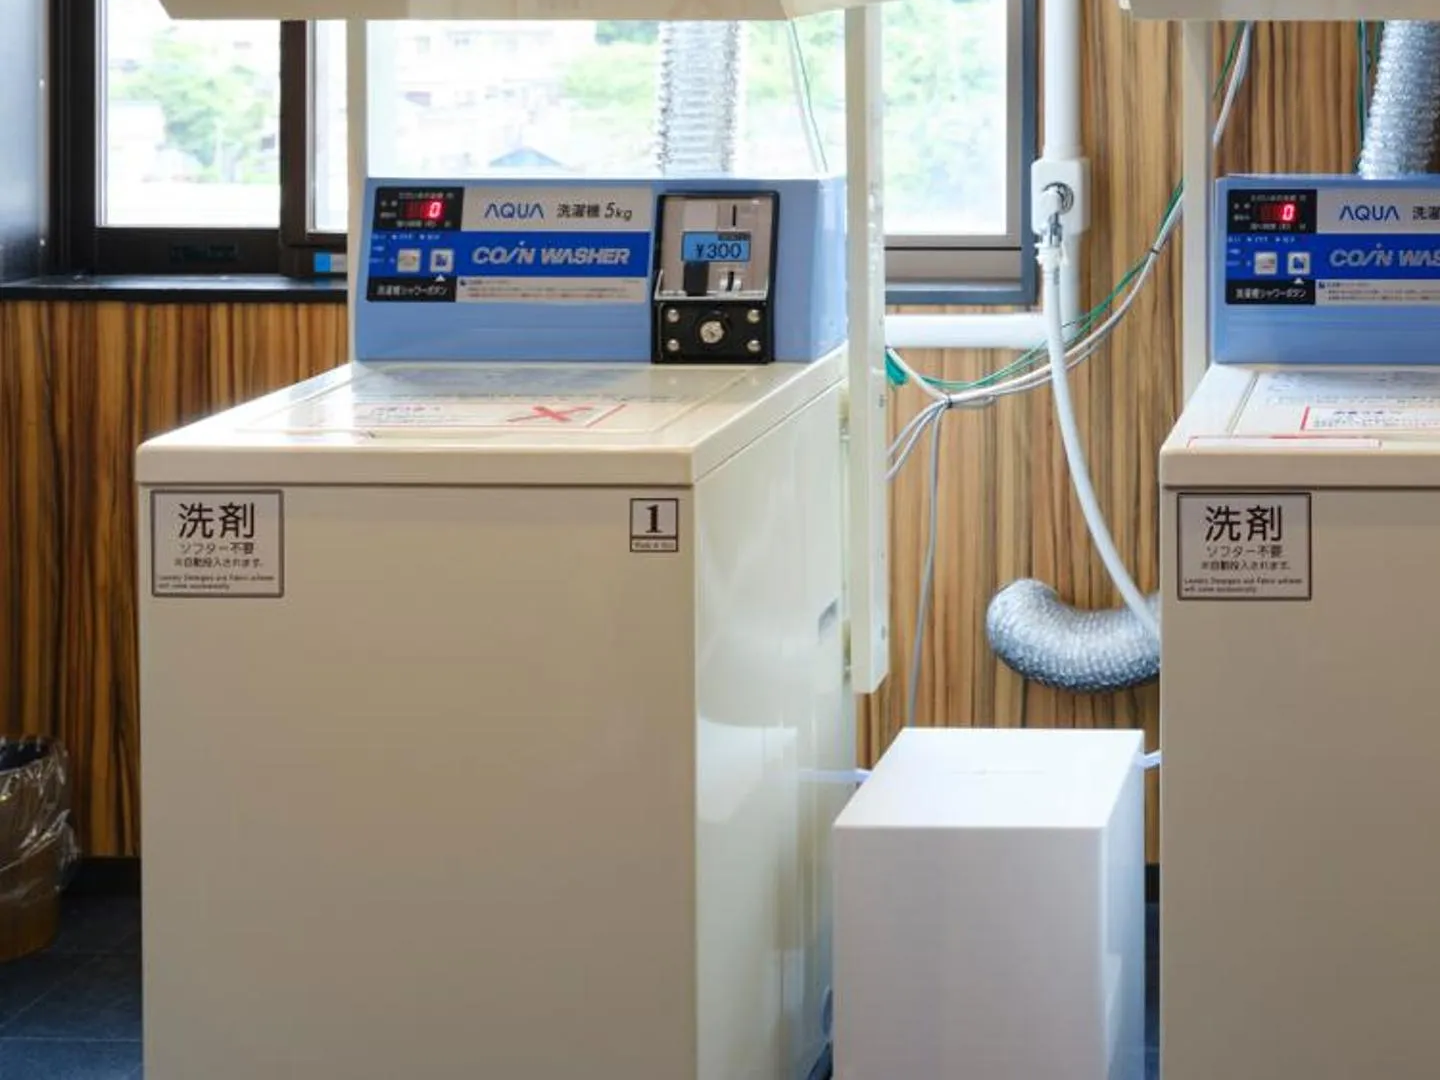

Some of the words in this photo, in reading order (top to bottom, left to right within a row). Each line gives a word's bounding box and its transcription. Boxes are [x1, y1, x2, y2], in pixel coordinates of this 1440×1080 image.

[428, 202, 442, 218] 0
[485, 202, 545, 219] AQUA
[557, 202, 601, 219] 洗濯機
[604, 201, 633, 221] 5kg
[1281, 204, 1296, 222] 0
[1339, 204, 1400, 221] AQUA
[541, 248, 631, 265] WASHER
[695, 242, 742, 259] ¥300
[178, 501, 255, 539] 洗剤
[645, 504, 664, 533] 1
[1205, 505, 1282, 542] 洗剤
[180, 542, 254, 555] ソフター不要
[1206, 545, 1283, 558] ソフター不要
